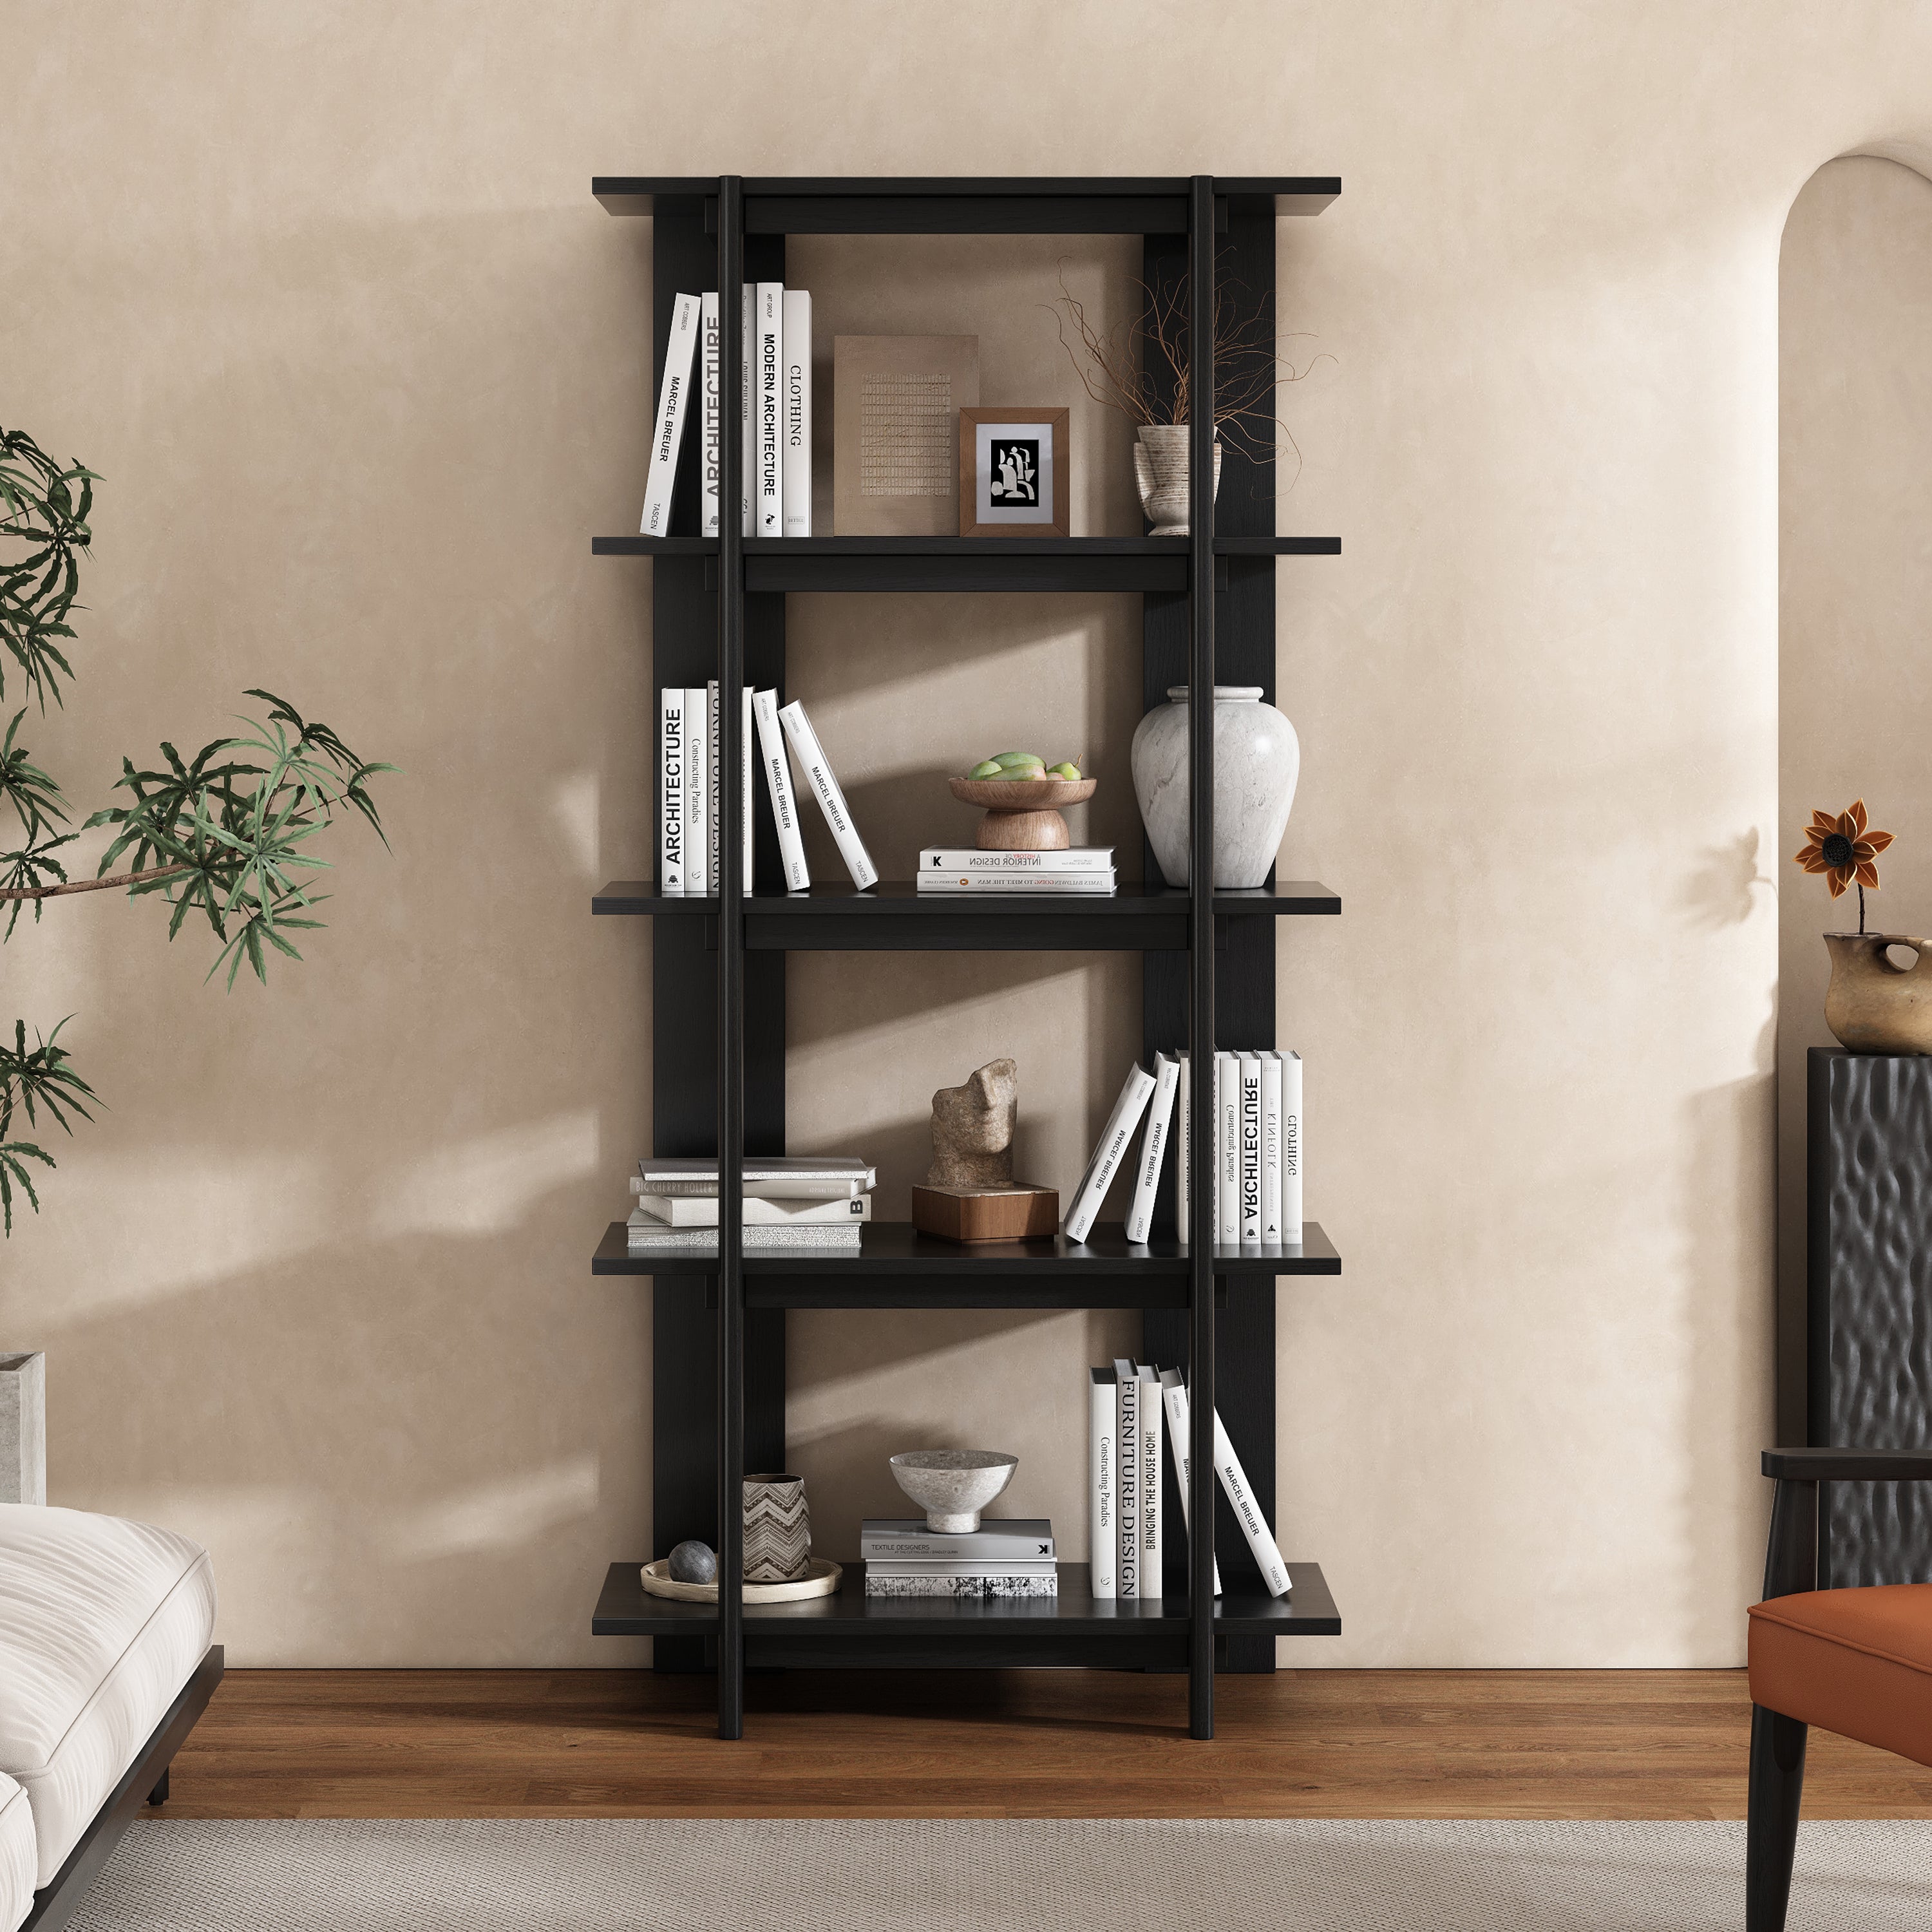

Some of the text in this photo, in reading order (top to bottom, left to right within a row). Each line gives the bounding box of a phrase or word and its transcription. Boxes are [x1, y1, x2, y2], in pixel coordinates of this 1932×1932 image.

[659, 376, 680, 462] MARCEL BREUER
[764, 334, 775, 496] MODERN ARCHITECTURE
[790, 365, 801, 447] CLOTHING
[650, 503, 661, 530] TASCEN
[665, 708, 681, 865] ARCHITECTURE
[690, 738, 701, 789] Constructing
[771, 759, 791, 829] MARCEL BREUER
[811, 766, 846, 833] MARCEL BREUER
[791, 862, 801, 885] TASCEN
[855, 860, 869, 882] TASCEN
[933, 856, 942, 866] K
[636, 1181, 713, 1194] BIG CHERRY HOLLER
[849, 1200, 864, 1215] B
[1098, 1437, 1110, 1490] Constructing
[1121, 1380, 1135, 1596] FURNITURE DESIGN
[1146, 1431, 1155, 1549] BRINGING THE HOUSE HOME
[1224, 1466, 1260, 1537] MARCEL BREUER
[1269, 1566, 1283, 1589] TASCEN
